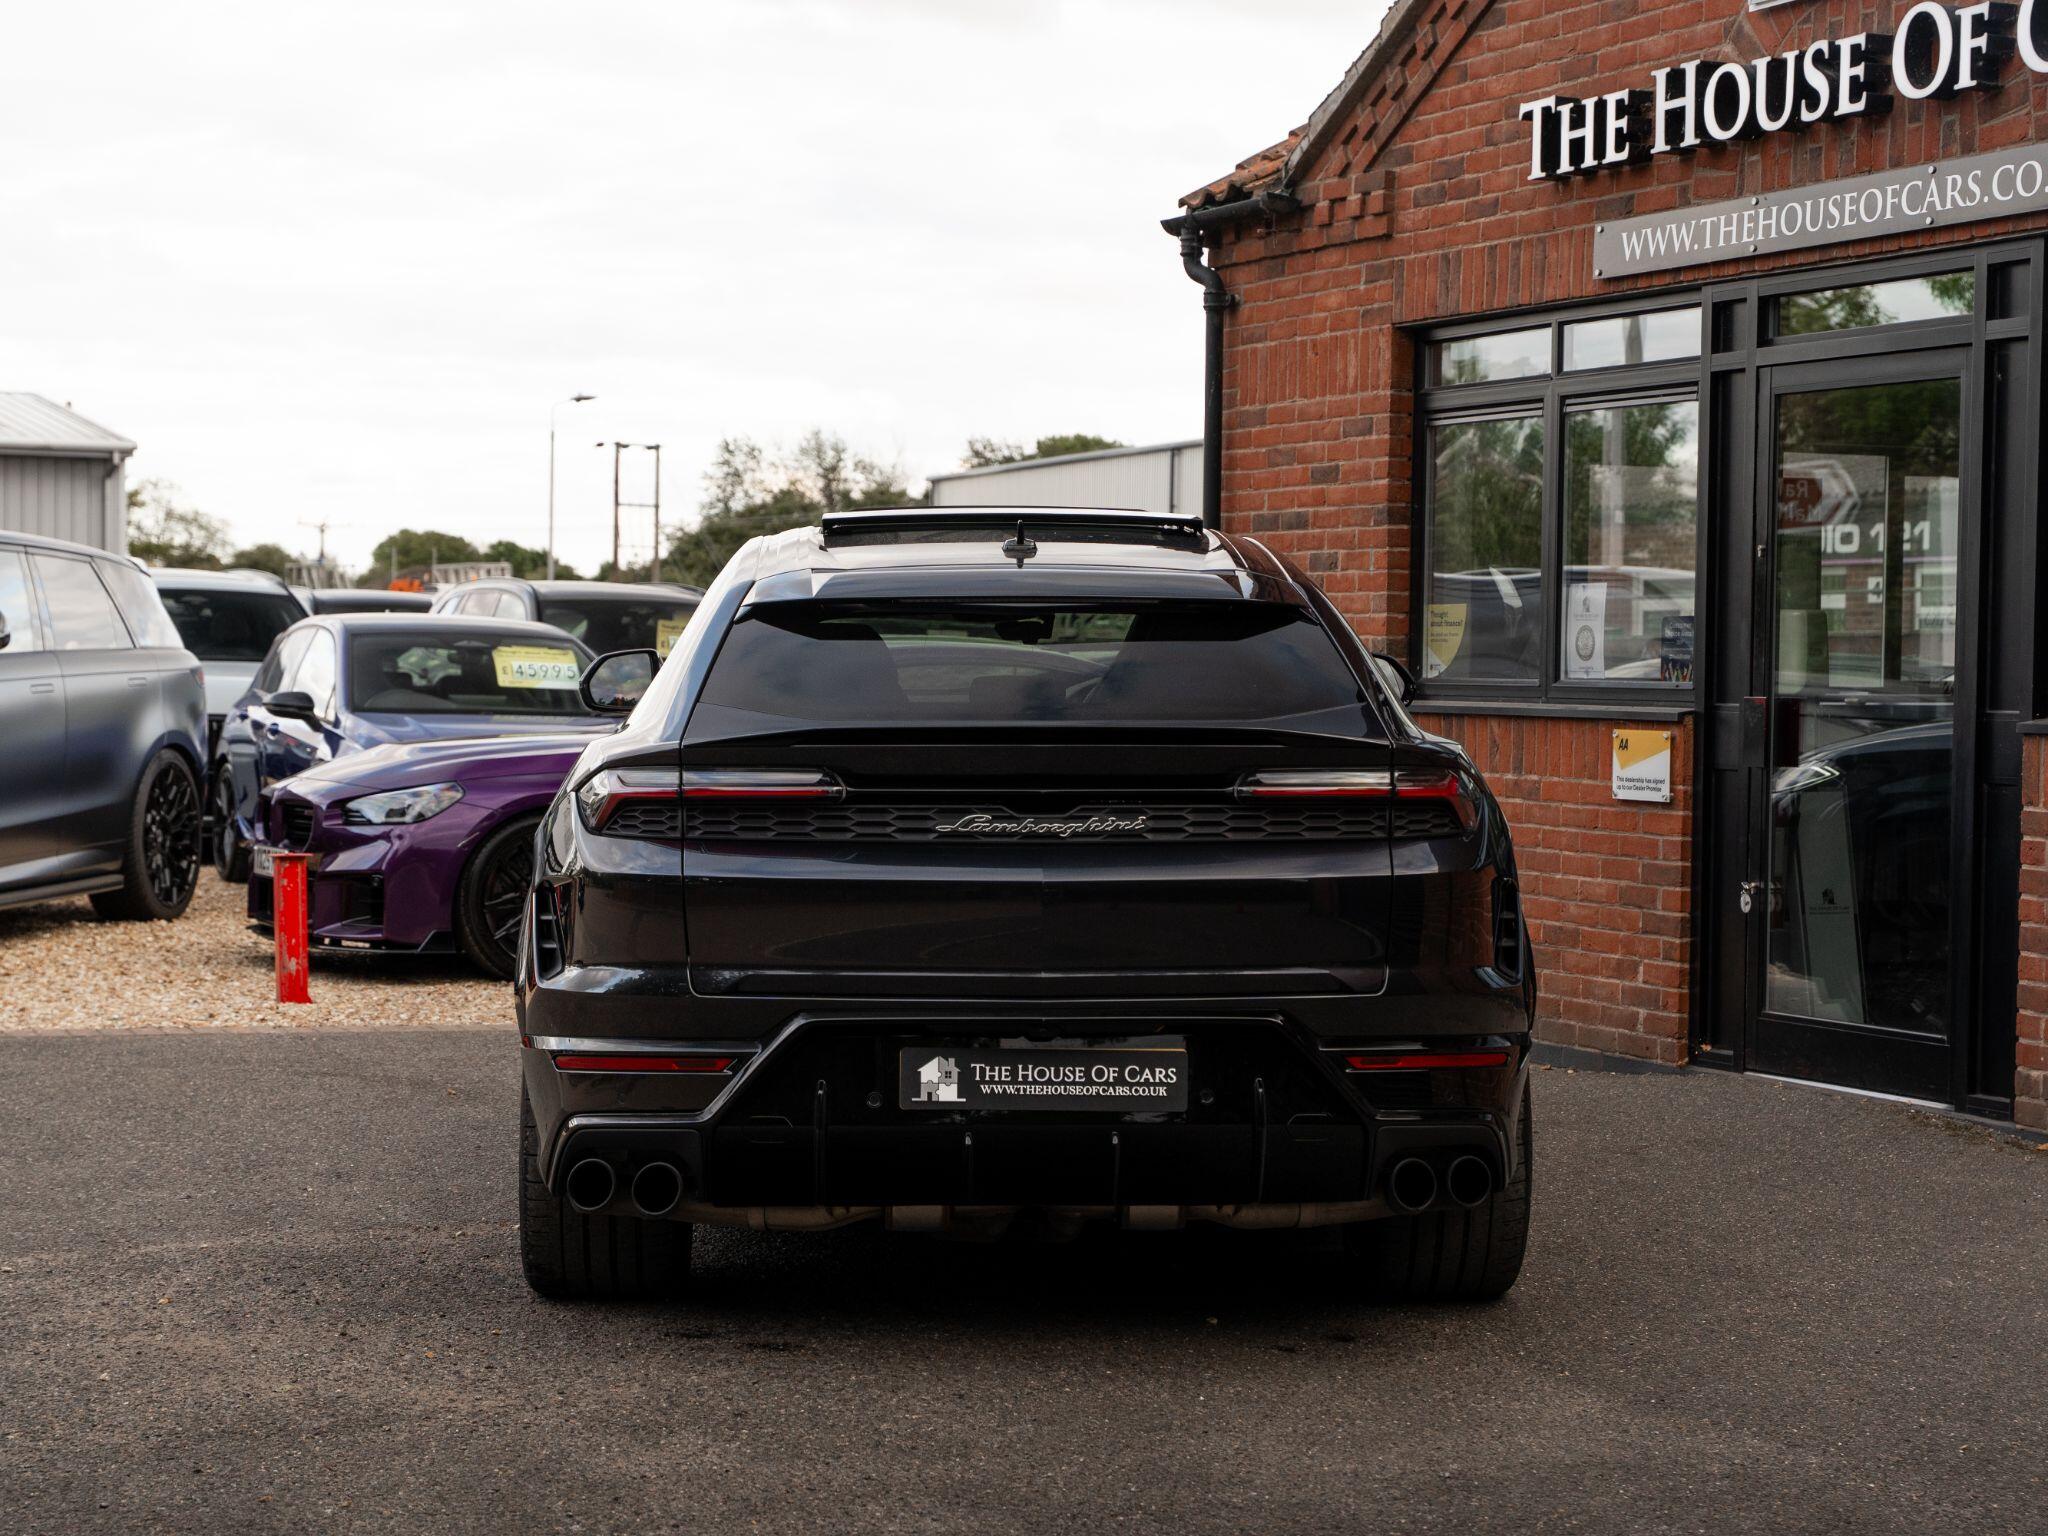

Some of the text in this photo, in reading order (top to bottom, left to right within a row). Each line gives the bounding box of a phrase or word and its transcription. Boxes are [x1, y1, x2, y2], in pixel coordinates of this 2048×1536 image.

[1518, 88, 1630, 181] THE
[1650, 32, 1868, 155] HOUSE
[1892, 1, 1990, 99] OF
[515, 663, 577, 680] 45995
[1619, 738, 1628, 750] AA
[1625, 776, 1645, 784] dealership
[935, 814, 1147, 837] Lamborghini
[970, 1063, 1177, 1084] THE HOUSE OF CARS
[980, 1083, 1168, 1098] WWW.THEHOUSEOFCARS.CO.UK
